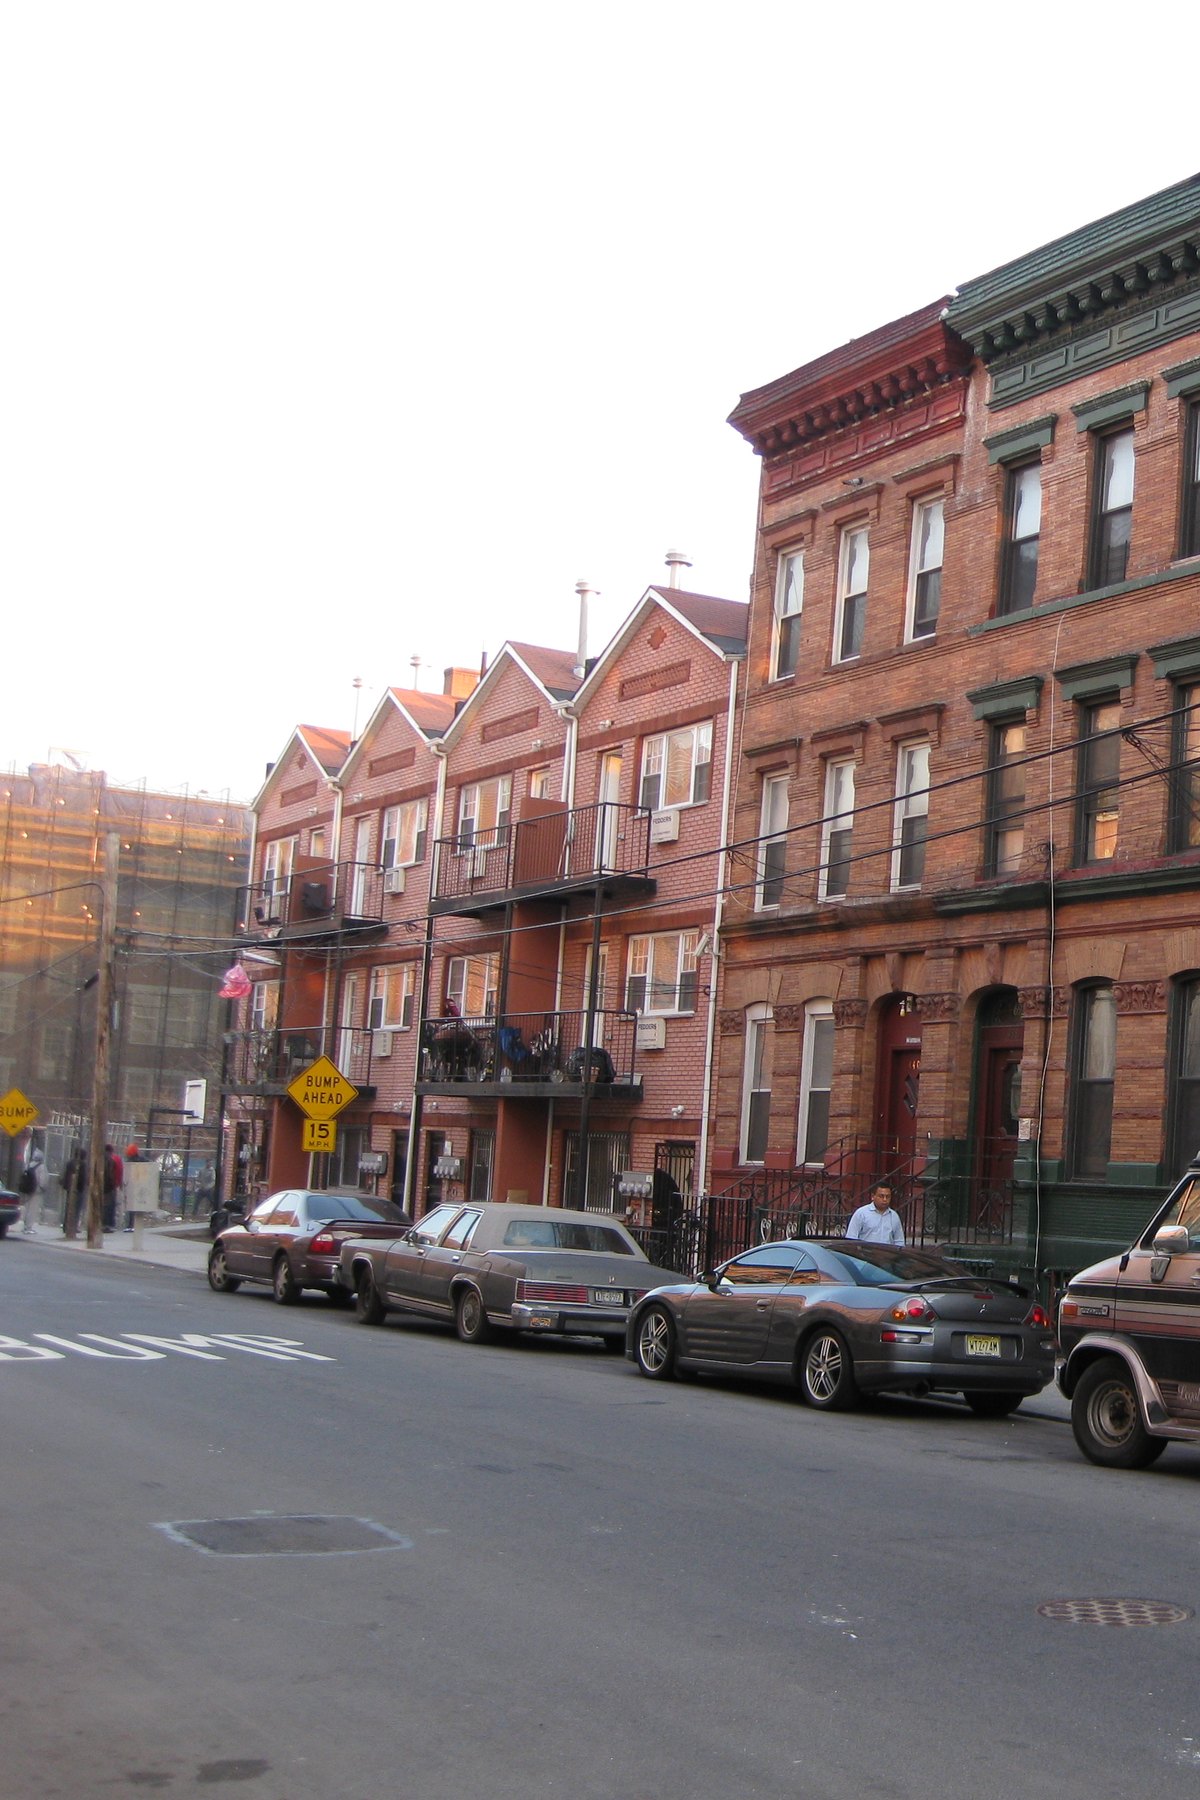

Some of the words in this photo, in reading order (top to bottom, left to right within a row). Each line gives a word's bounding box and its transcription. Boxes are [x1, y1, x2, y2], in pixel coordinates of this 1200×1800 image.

[306, 1075, 341, 1088] BUMP
[303, 1092, 343, 1105] AHEAD
[310, 1123, 330, 1139] 15
[0, 1333, 338, 1360] BUMP
